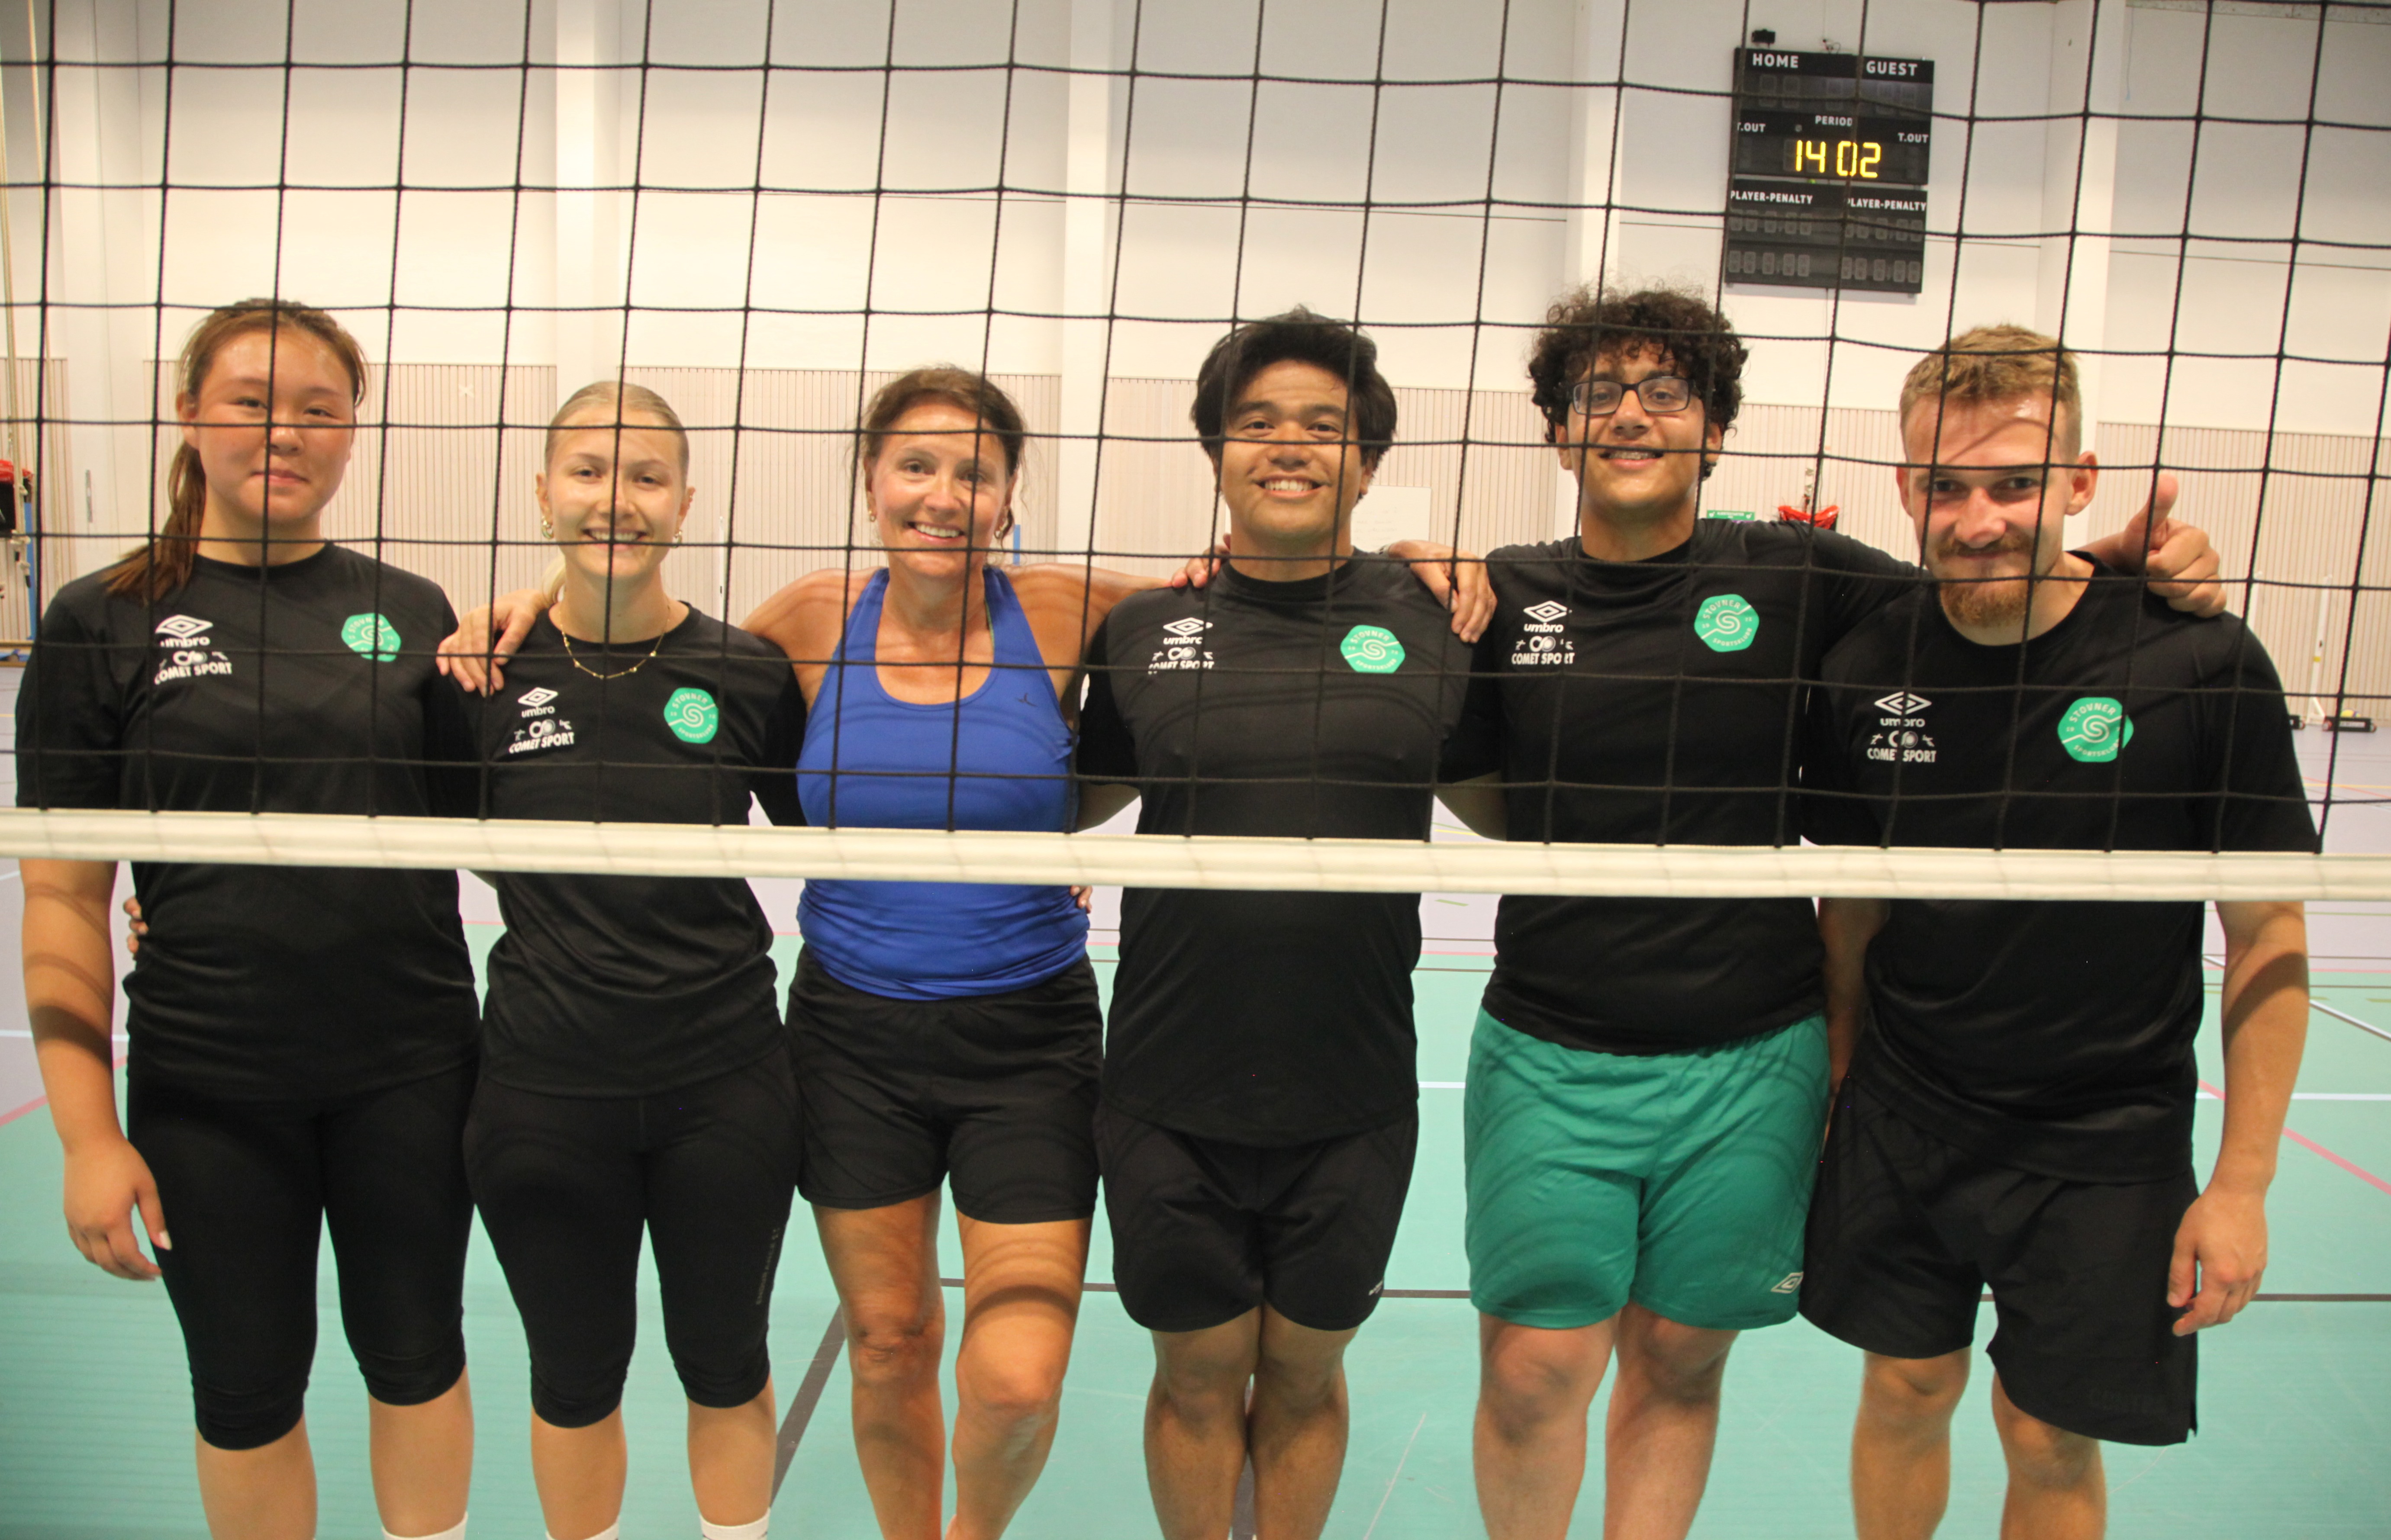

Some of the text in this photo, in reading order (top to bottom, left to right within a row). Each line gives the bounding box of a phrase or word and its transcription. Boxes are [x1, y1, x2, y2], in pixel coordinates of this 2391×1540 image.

[1752, 53, 1799, 68] HOME
[1866, 60, 1918, 77] GUEST
[1815, 115, 1853, 127] PERIOD
[1898, 132, 1928, 144] T.OUT
[1796, 140, 1881, 178] 14 02
[1730, 190, 1813, 205] PLAYER-PENALTY
[1847, 198, 1926, 212] LAYER-PENALTY
[1702, 599, 1741, 619] STOVNER
[348, 617, 384, 633] STOVNR
[1524, 623, 1564, 633] umbro
[1350, 630, 1390, 644] STOVNER
[1511, 653, 1540, 665] COMET
[193, 661, 232, 676] SPORT
[672, 693, 708, 709] STOVNER
[521, 706, 555, 718] umbro
[2069, 703, 2117, 723] STOVNER
[509, 732, 575, 754] COMET SPORT
[1867, 747, 1937, 763] COME SPORT
